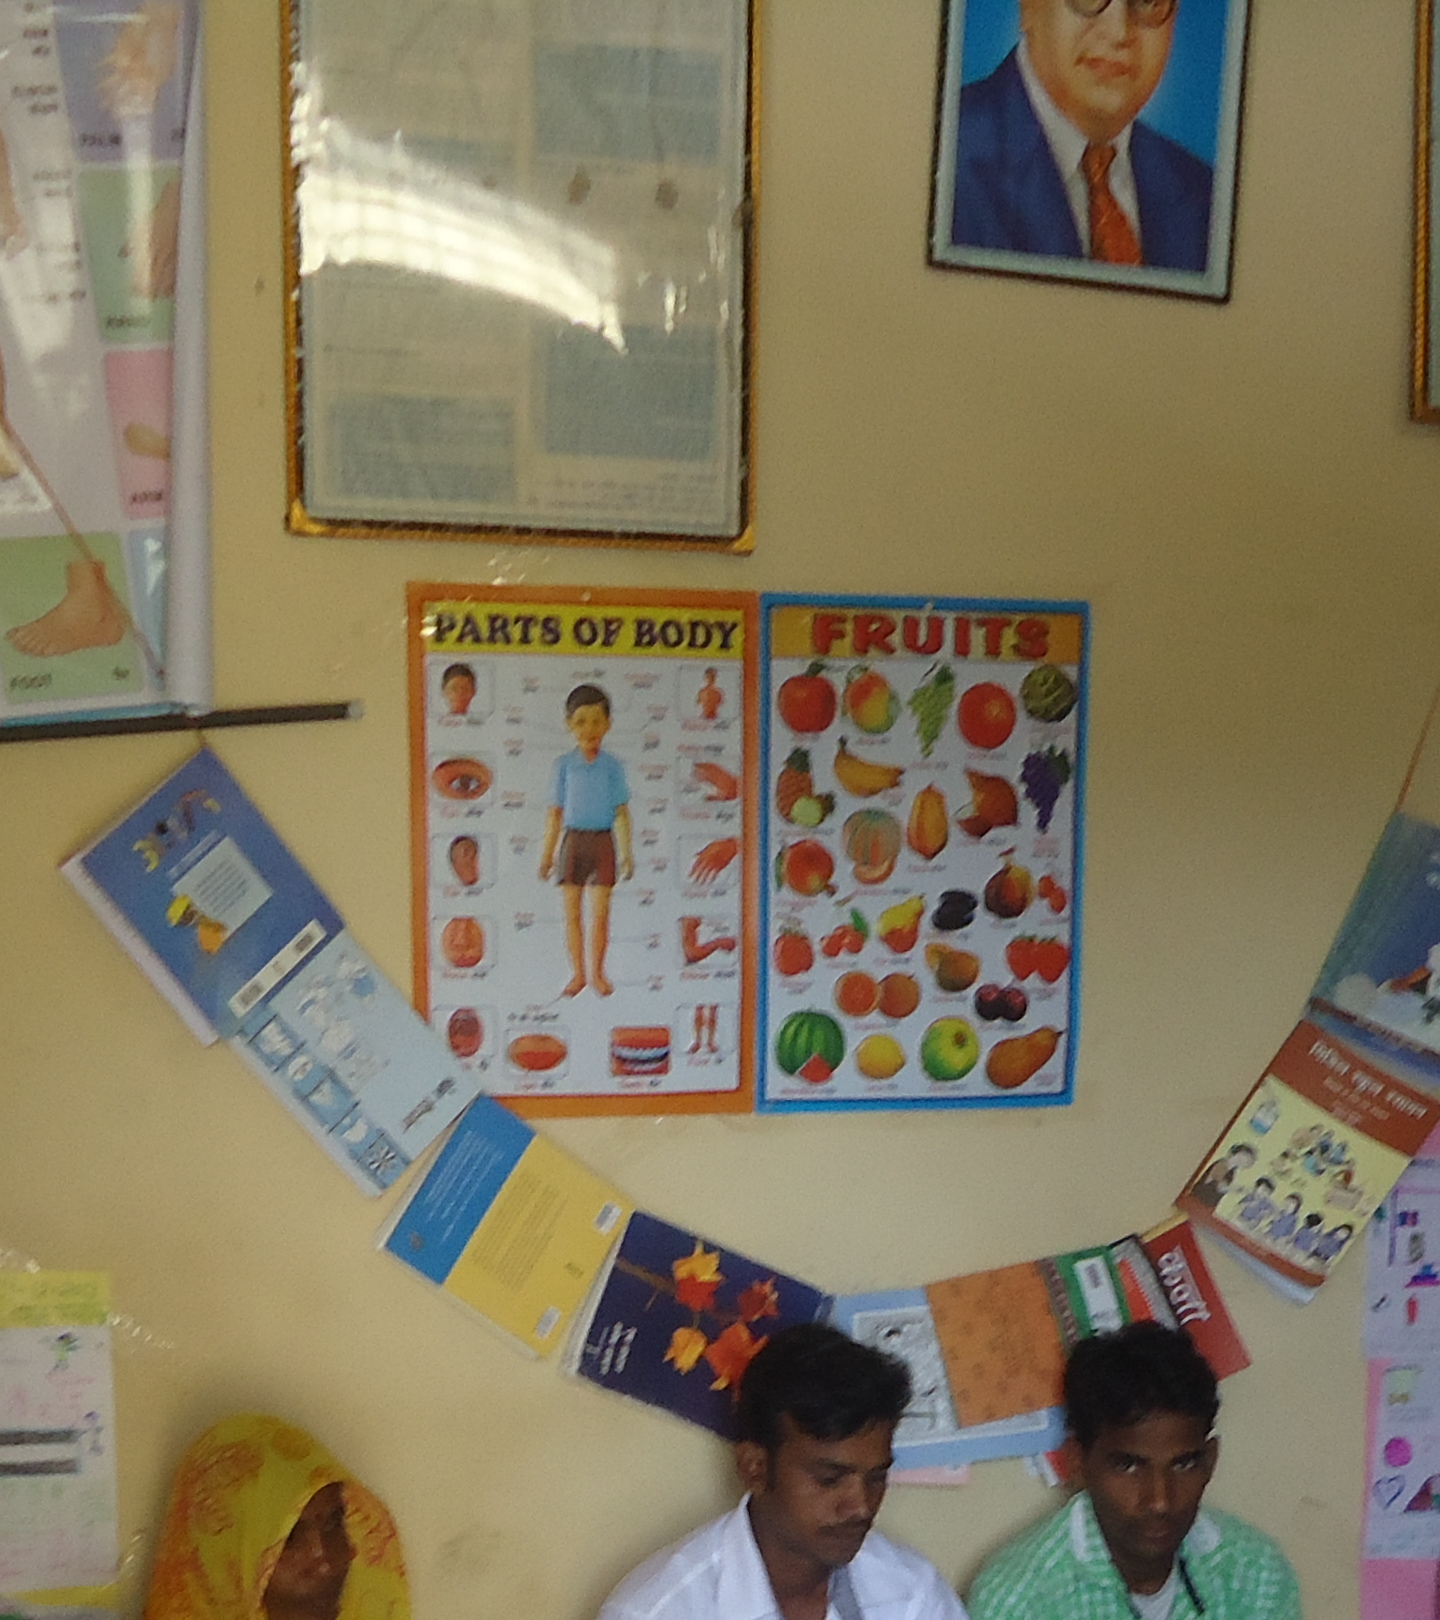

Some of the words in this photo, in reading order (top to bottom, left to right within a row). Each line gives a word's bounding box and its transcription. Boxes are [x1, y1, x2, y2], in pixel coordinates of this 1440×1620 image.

[433, 612, 562, 645] PARTS
[572, 616, 624, 648] OF
[634, 619, 739, 652] BODY
[811, 613, 1052, 659] FRUITS
